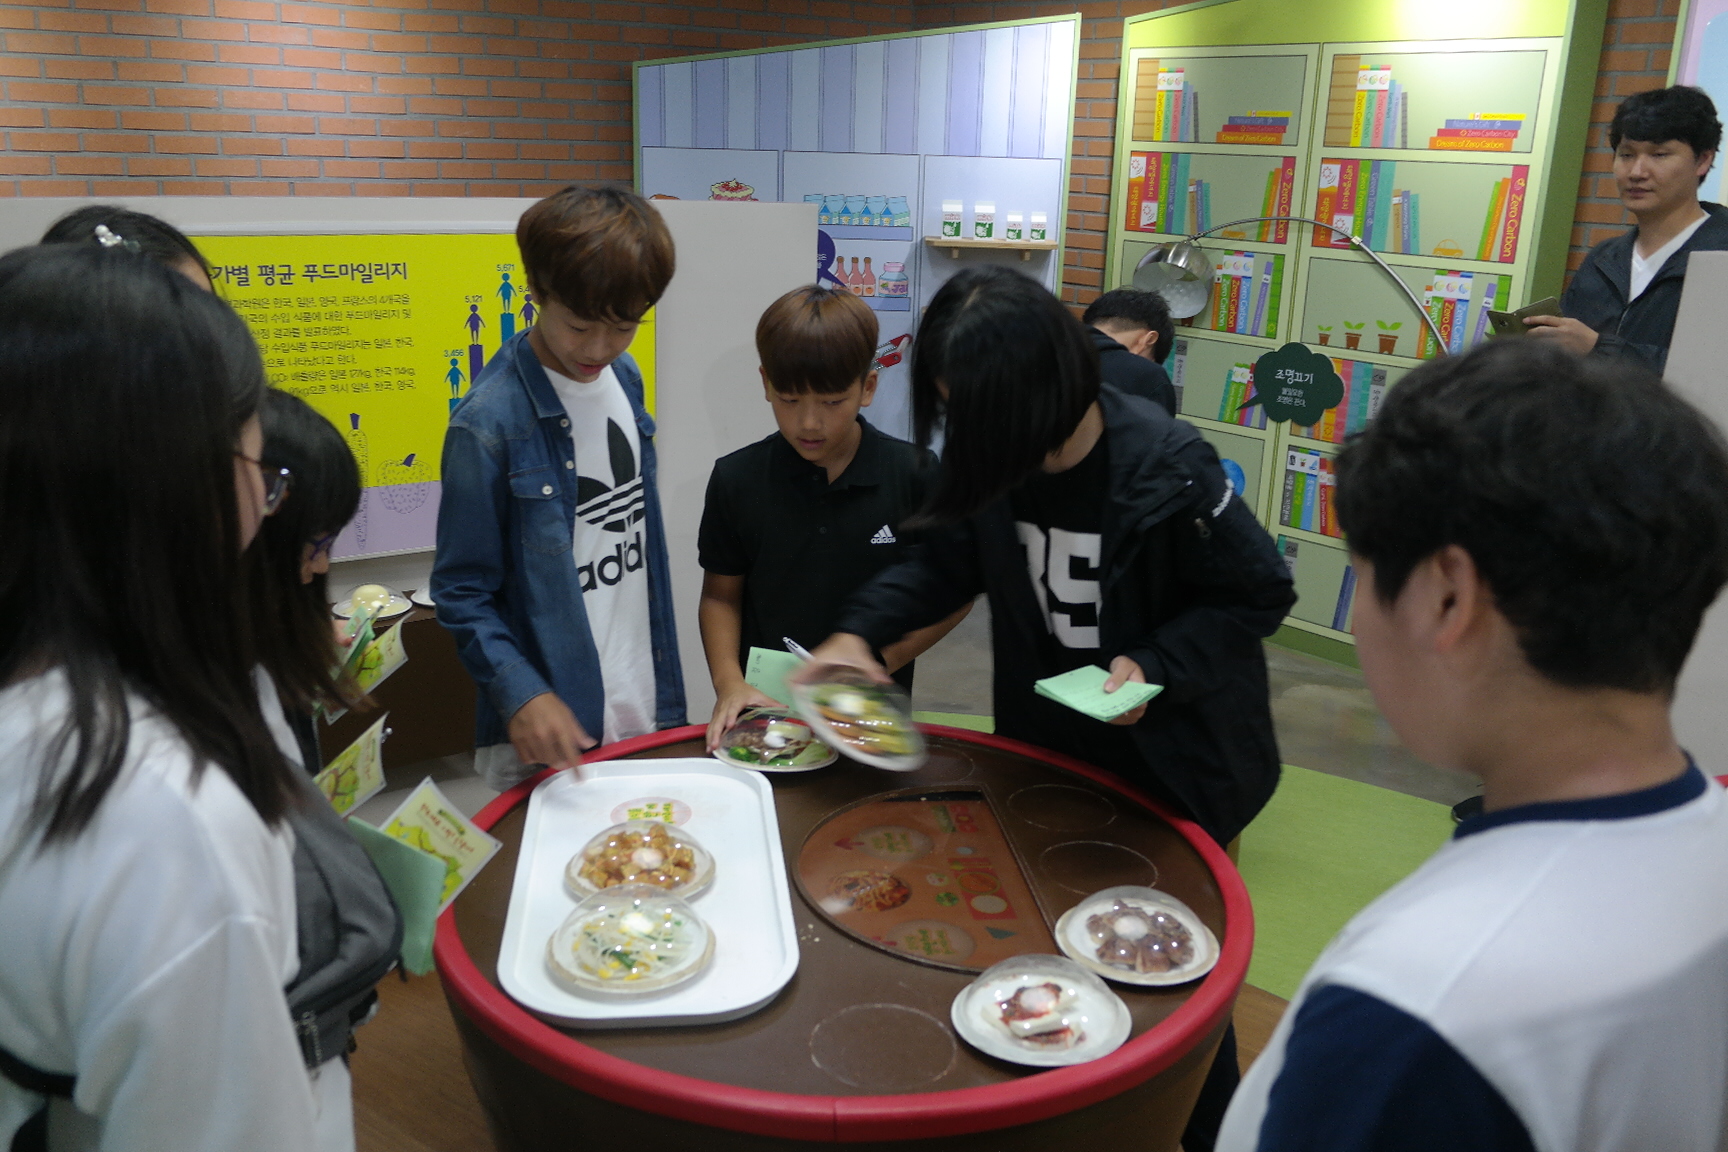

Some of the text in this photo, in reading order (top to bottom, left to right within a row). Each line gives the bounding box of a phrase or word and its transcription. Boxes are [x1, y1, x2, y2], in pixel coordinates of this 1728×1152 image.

[1504, 130, 1515, 138] City
[1436, 140, 1457, 149] Dream
[1465, 140, 1480, 149] Zero
[1480, 141, 1505, 149] Carbon
[1361, 173, 1369, 190] Zero
[1281, 182, 1292, 203] Zero
[1357, 190, 1366, 215] Energy
[1503, 194, 1523, 257] Zero Carbon
[211, 262, 408, 287] 가별 평균 푸드마일리지
[496, 264, 515, 272] 5,671
[342, 294, 377, 306] 프랑스의
[465, 295, 483, 303] 5,121
[1219, 279, 1230, 326] Zero Carbon
[1228, 280, 1240, 327] Zero Carbon
[1238, 281, 1250, 329] Zero Carbon
[271, 312, 290, 323] 수입
[293, 311, 321, 322] 식품에
[325, 310, 343, 321] 대한
[346, 309, 400, 320] 푸드마일리지
[1431, 301, 1441, 322] Zero
[1442, 302, 1454, 323] Zero
[1455, 304, 1466, 324] Zero
[274, 327, 301, 338] 결과를
[272, 342, 308, 354] 수입식품
[311, 339, 371, 351] 푸드마일리지는
[443, 349, 464, 357] 3,456
[330, 369, 347, 380] 일본
[375, 366, 392, 377] 한국
[1274, 368, 1314, 385] 조명끄기
[870, 536, 896, 544] adidas
